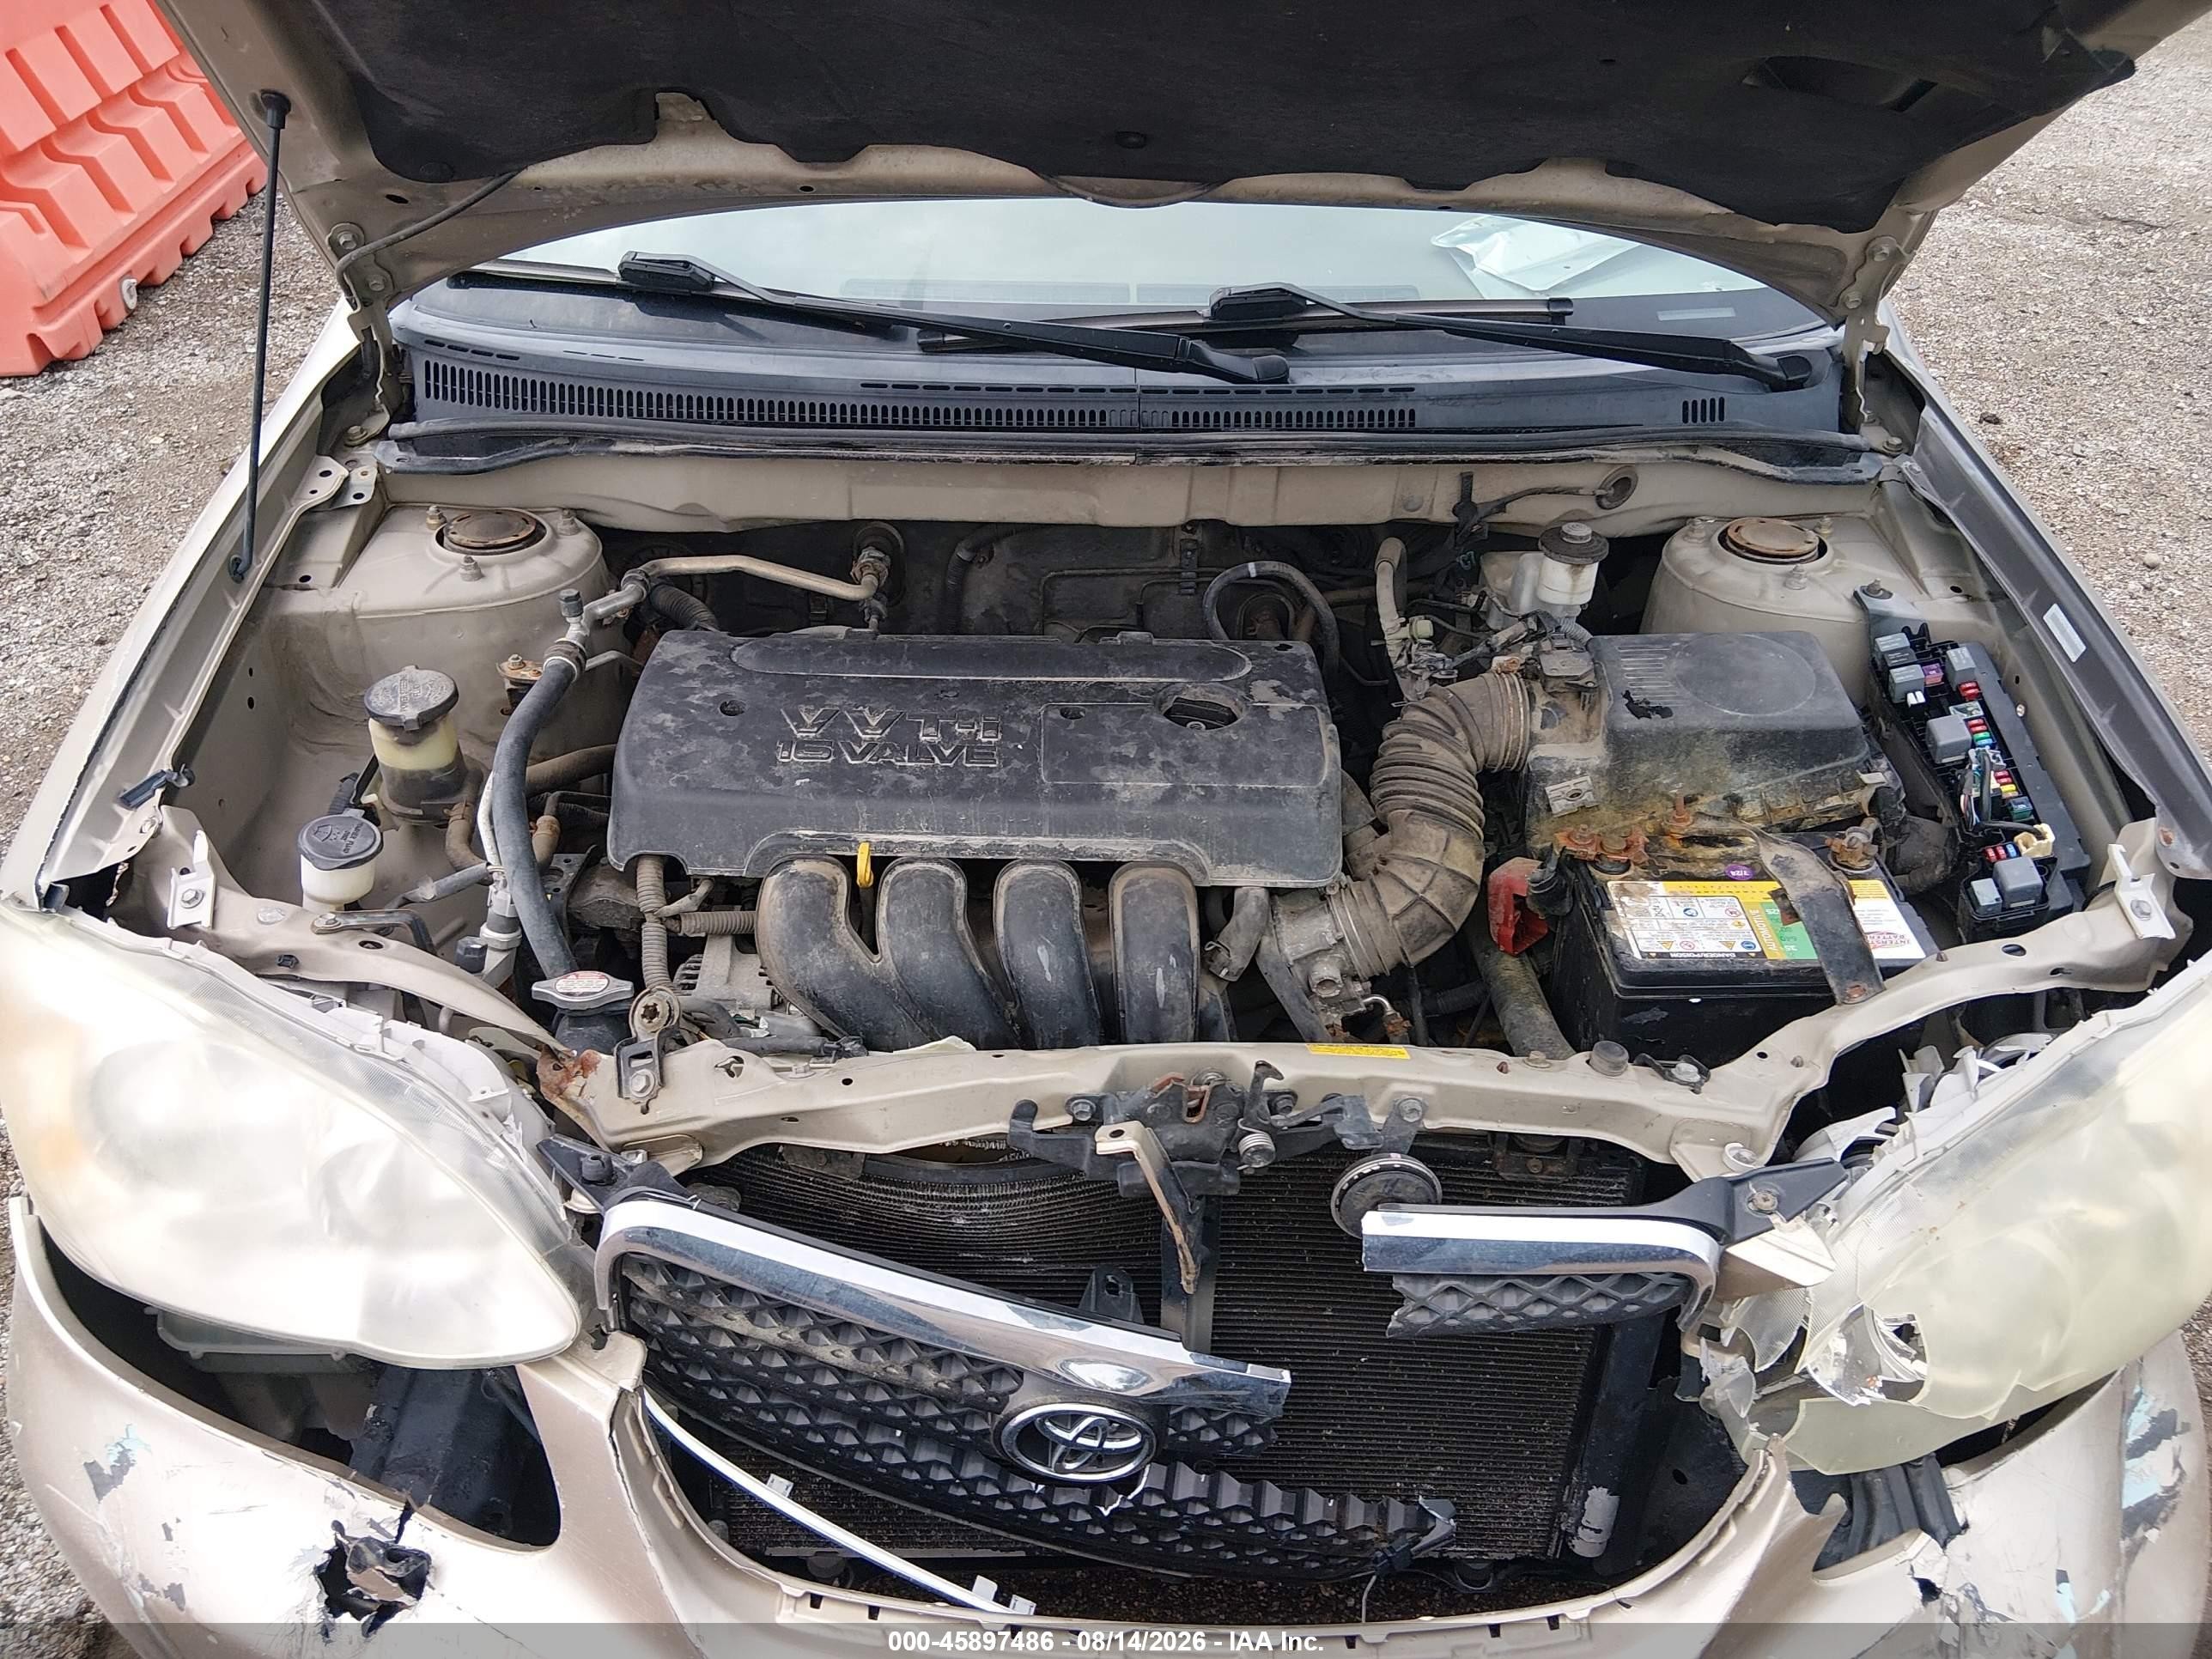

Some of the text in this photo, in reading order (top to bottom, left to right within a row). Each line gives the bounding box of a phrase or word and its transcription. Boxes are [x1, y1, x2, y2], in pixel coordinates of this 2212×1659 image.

[776, 739, 1000, 768] 16 VALVE
[1748, 909, 1779, 951] AUTOMOTIVE
